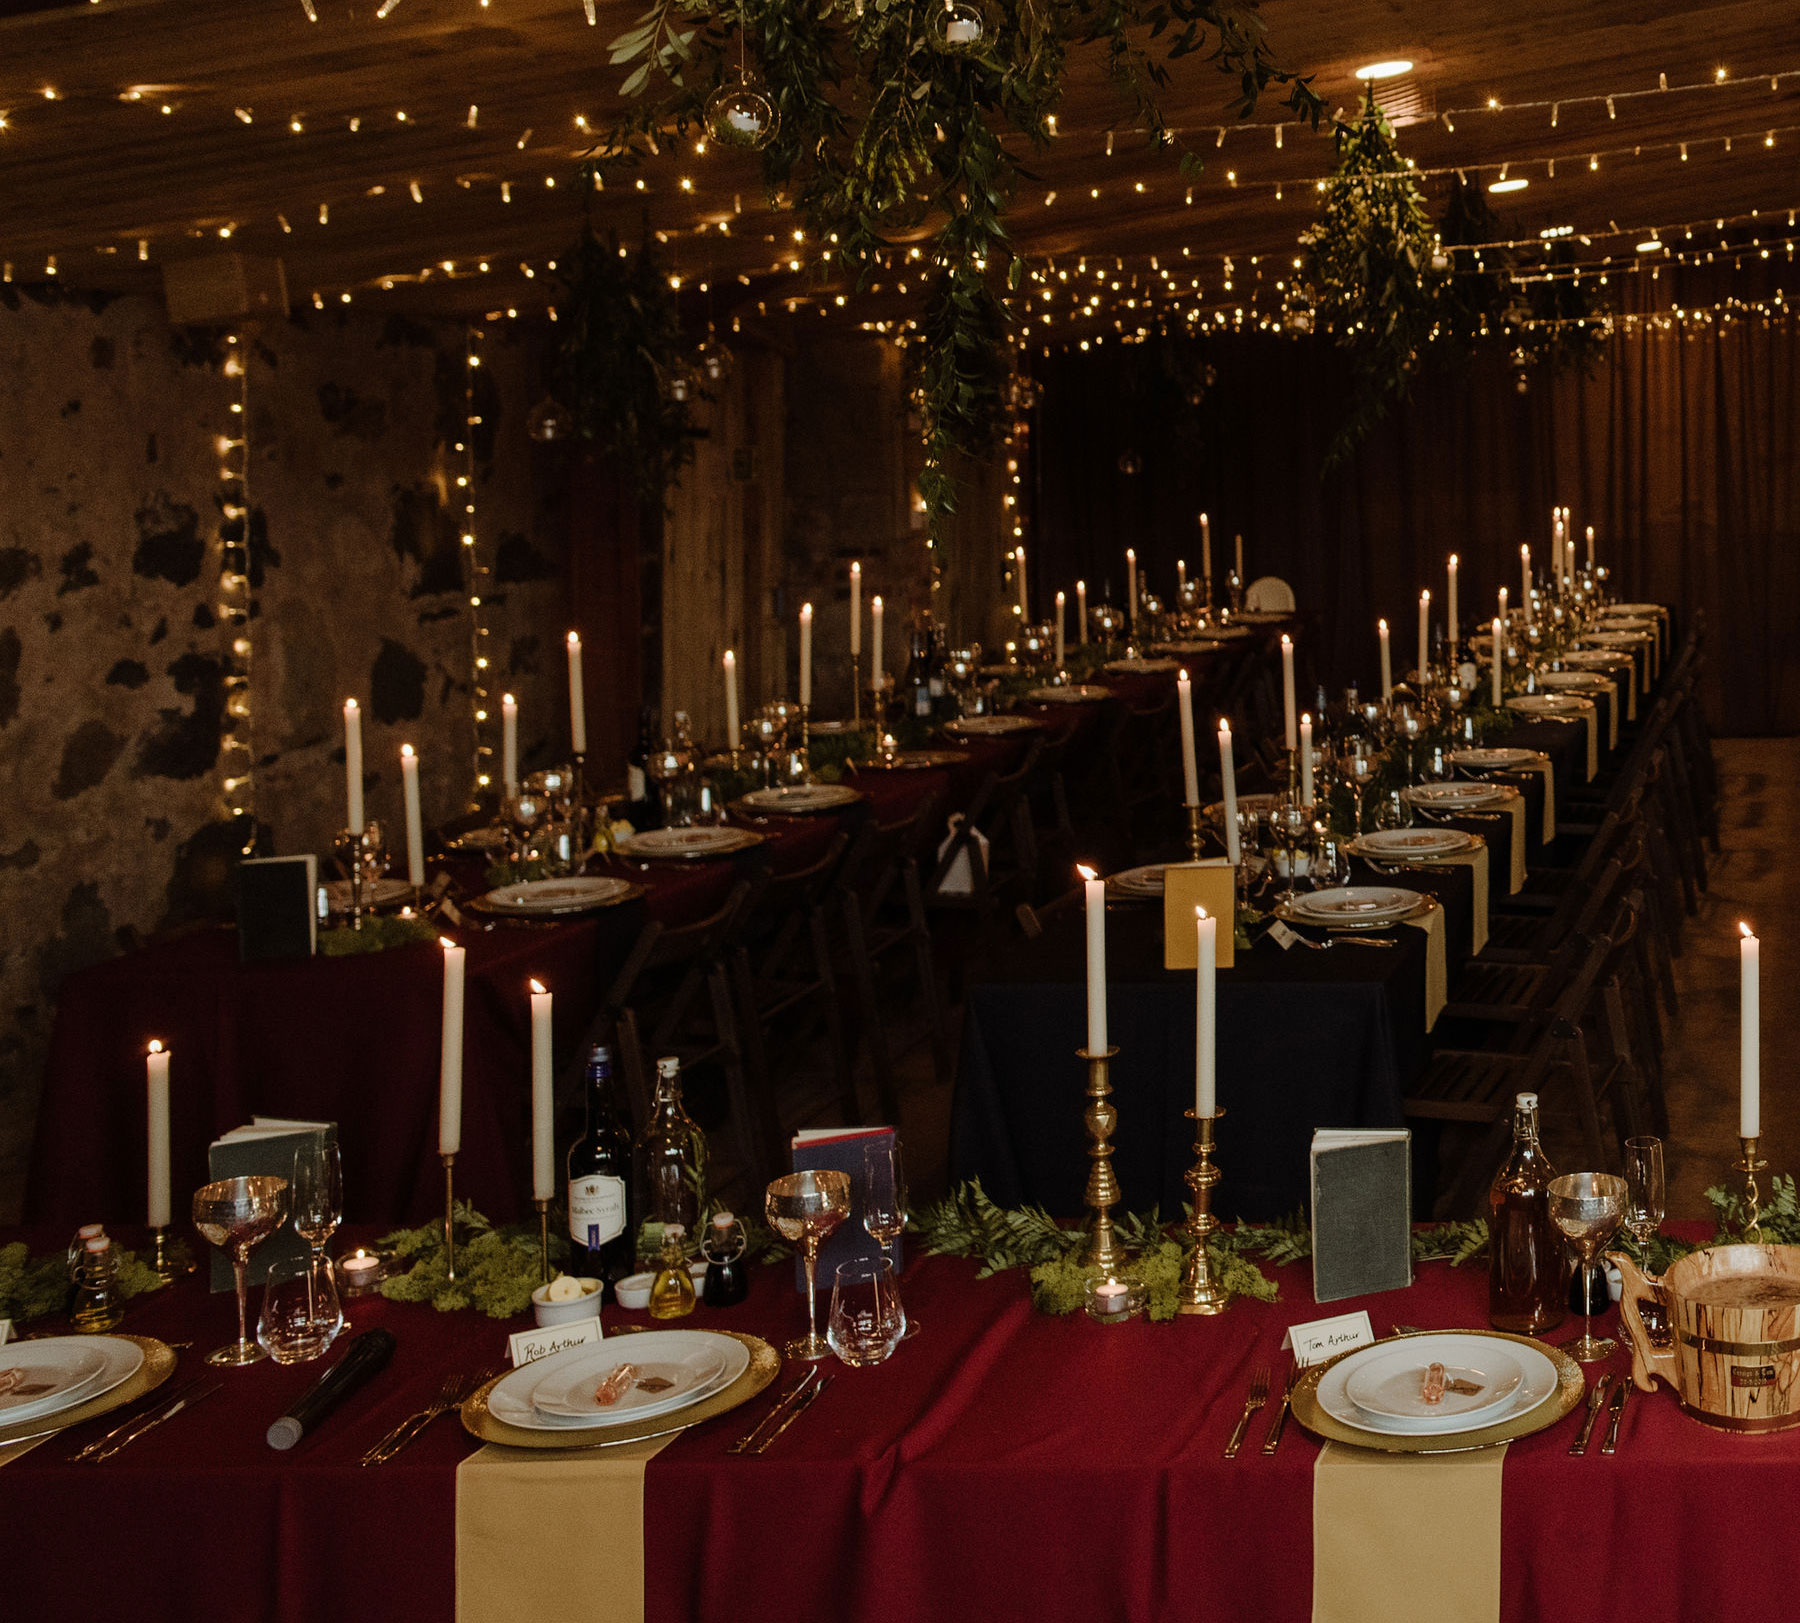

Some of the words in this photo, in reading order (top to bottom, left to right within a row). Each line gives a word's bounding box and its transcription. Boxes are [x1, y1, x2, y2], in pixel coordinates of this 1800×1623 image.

[524, 1343, 546, 1361] Rob
[550, 1336, 586, 1352] Arthur
[1303, 1336, 1323, 1351] Tom
[1328, 1331, 1360, 1346] Arthur
